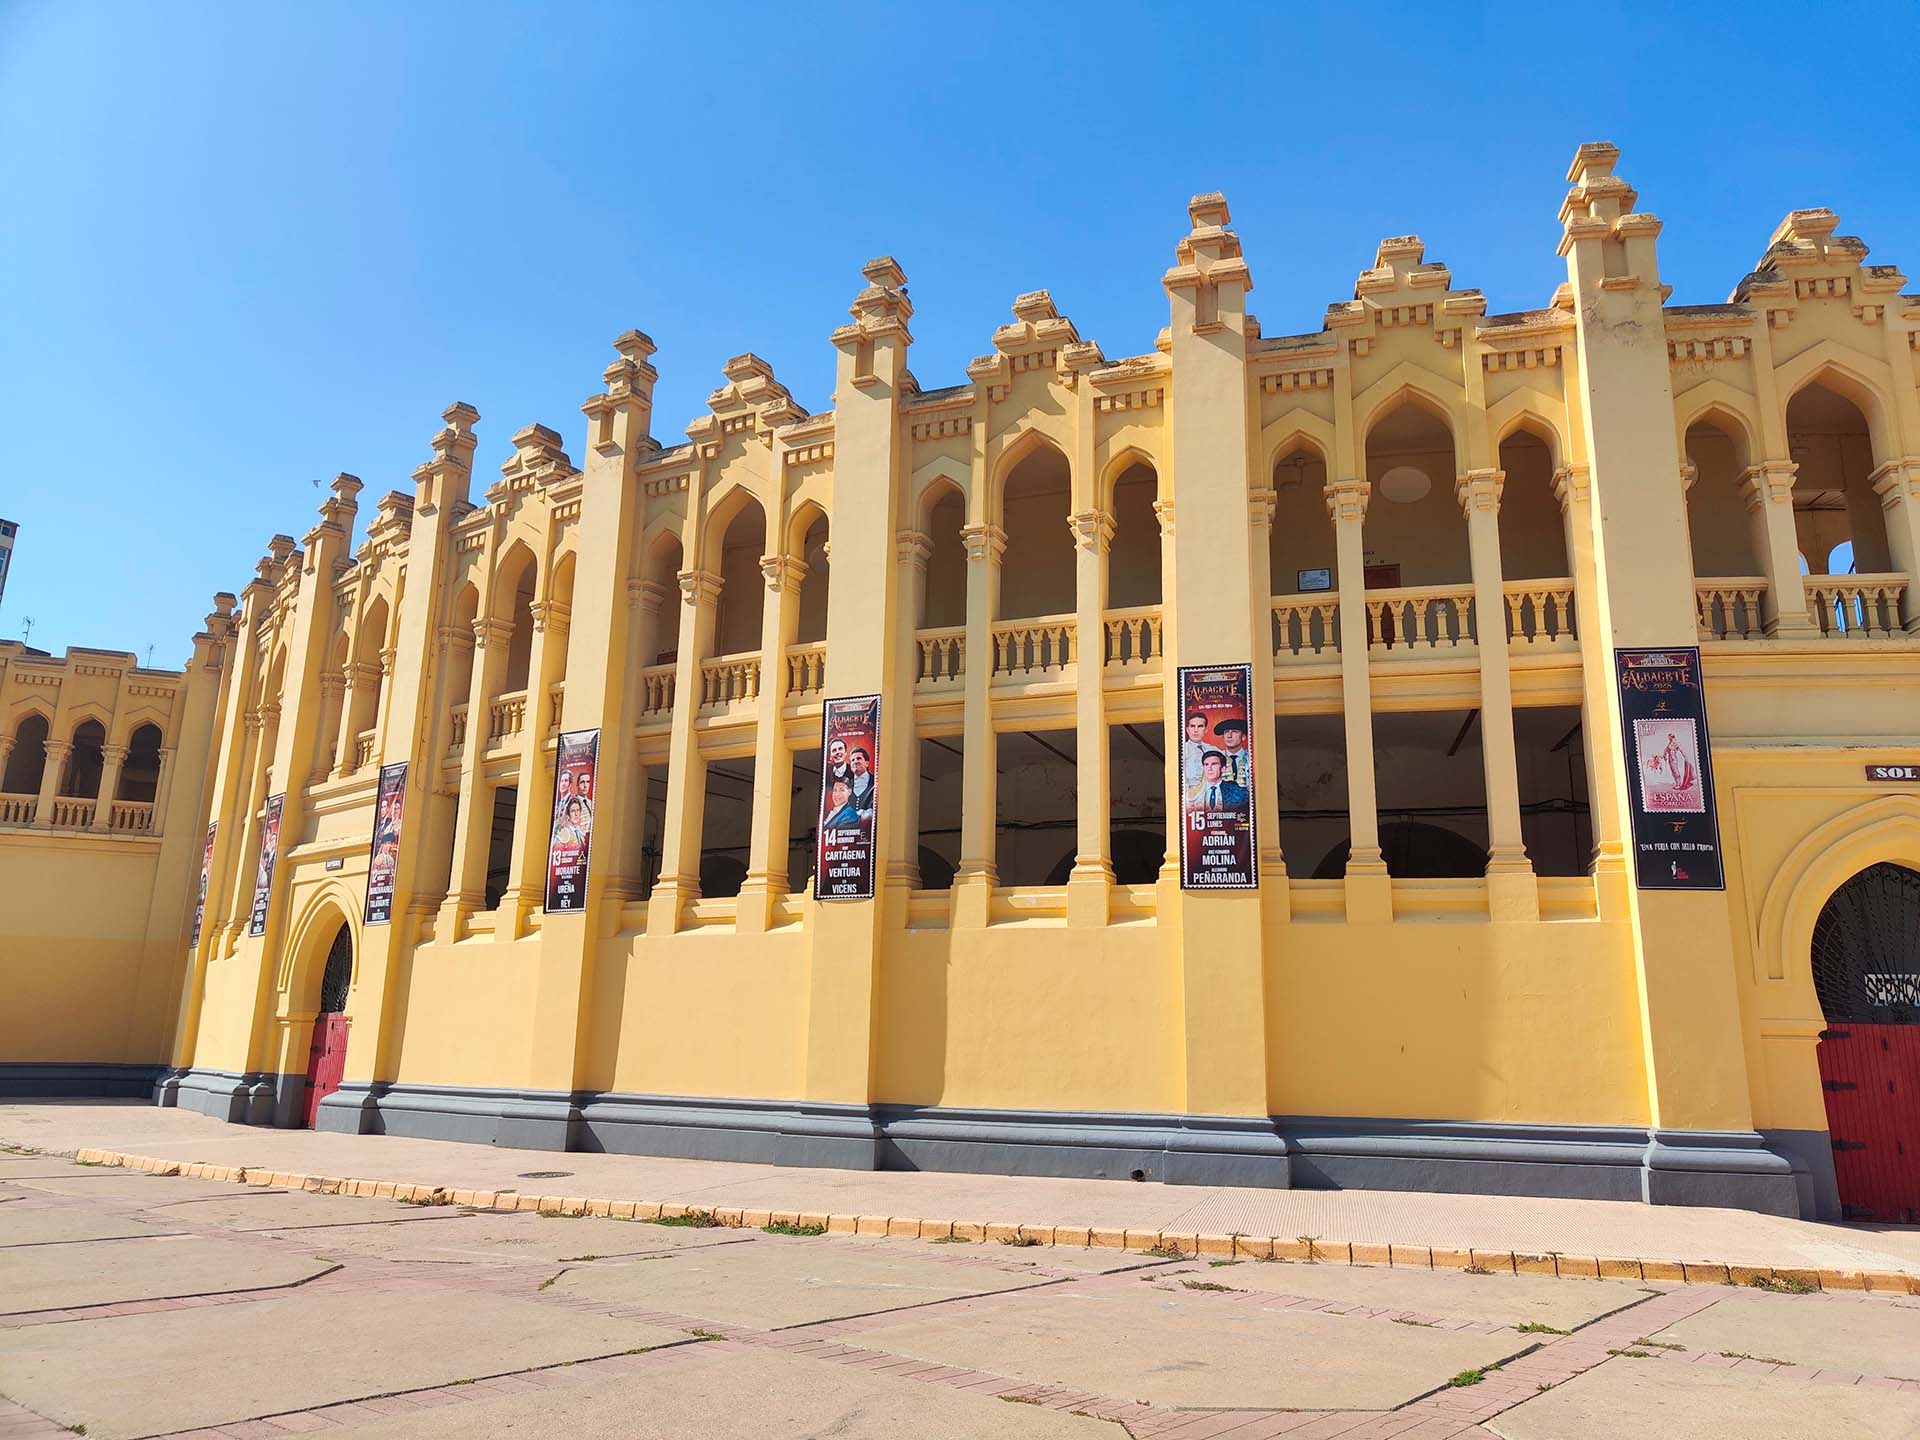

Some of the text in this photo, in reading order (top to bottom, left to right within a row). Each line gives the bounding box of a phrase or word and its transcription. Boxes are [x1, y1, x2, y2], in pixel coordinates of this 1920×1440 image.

[1876, 767, 1917, 778] SOL
[1653, 791, 1693, 802] ESPAÑA
[1188, 810, 1206, 830] 15
[1207, 811, 1237, 819] SEPTIEMBRE
[1207, 820, 1223, 828] LUNES
[823, 828, 837, 847] 14
[1202, 833, 1235, 846] ADRIÁN
[1670, 842, 1680, 851] CON
[552, 850, 561, 866] 13
[825, 850, 866, 861] CARTAGENA
[1202, 855, 1236, 866] MOLINA
[555, 865, 580, 876] MORANTE
[828, 867, 861, 877] VENTURA
[1193, 871, 1247, 884] PEÑARANDA
[832, 884, 857, 894] VICENS
[560, 899, 571, 908] REY
